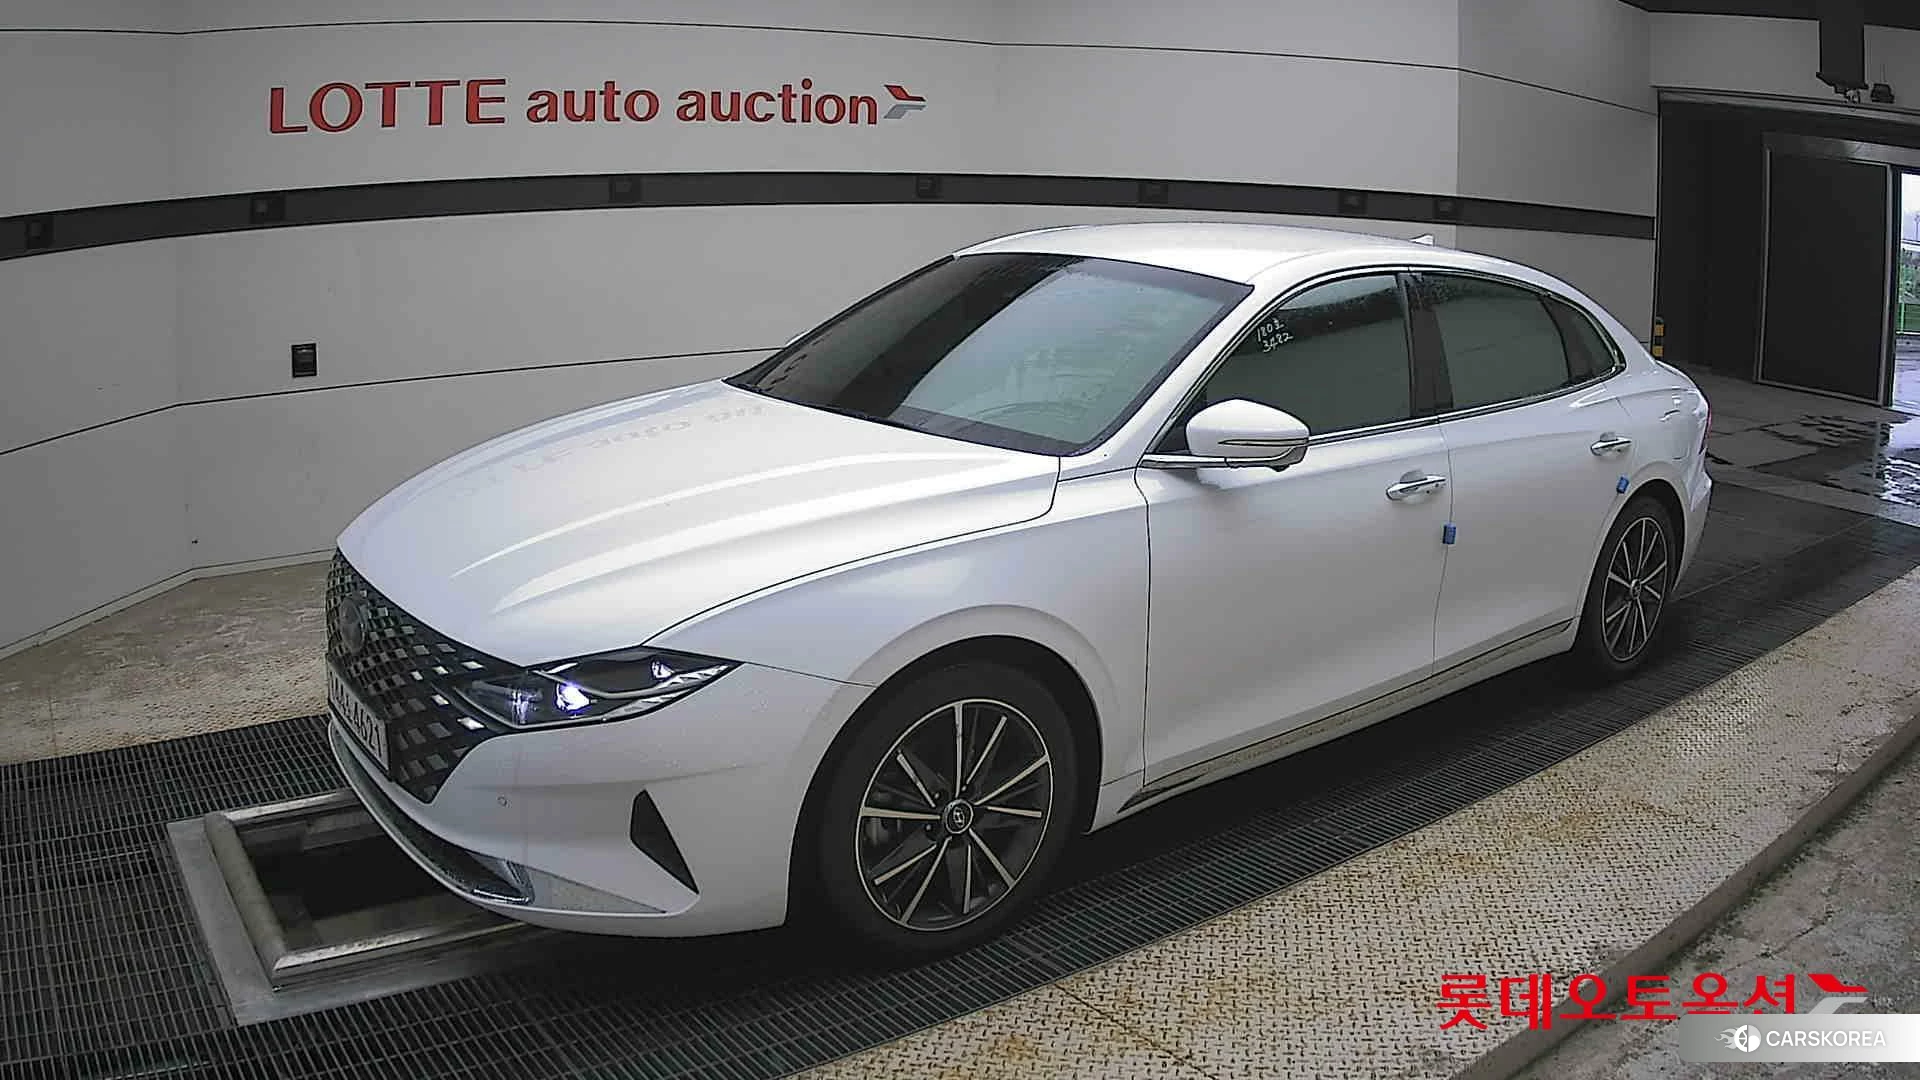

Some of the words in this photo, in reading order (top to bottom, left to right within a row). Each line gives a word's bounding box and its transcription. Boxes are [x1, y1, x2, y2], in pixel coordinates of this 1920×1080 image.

[270, 79, 506, 133] LOTTE
[526, 81, 660, 122] auto
[676, 78, 878, 125] auction
